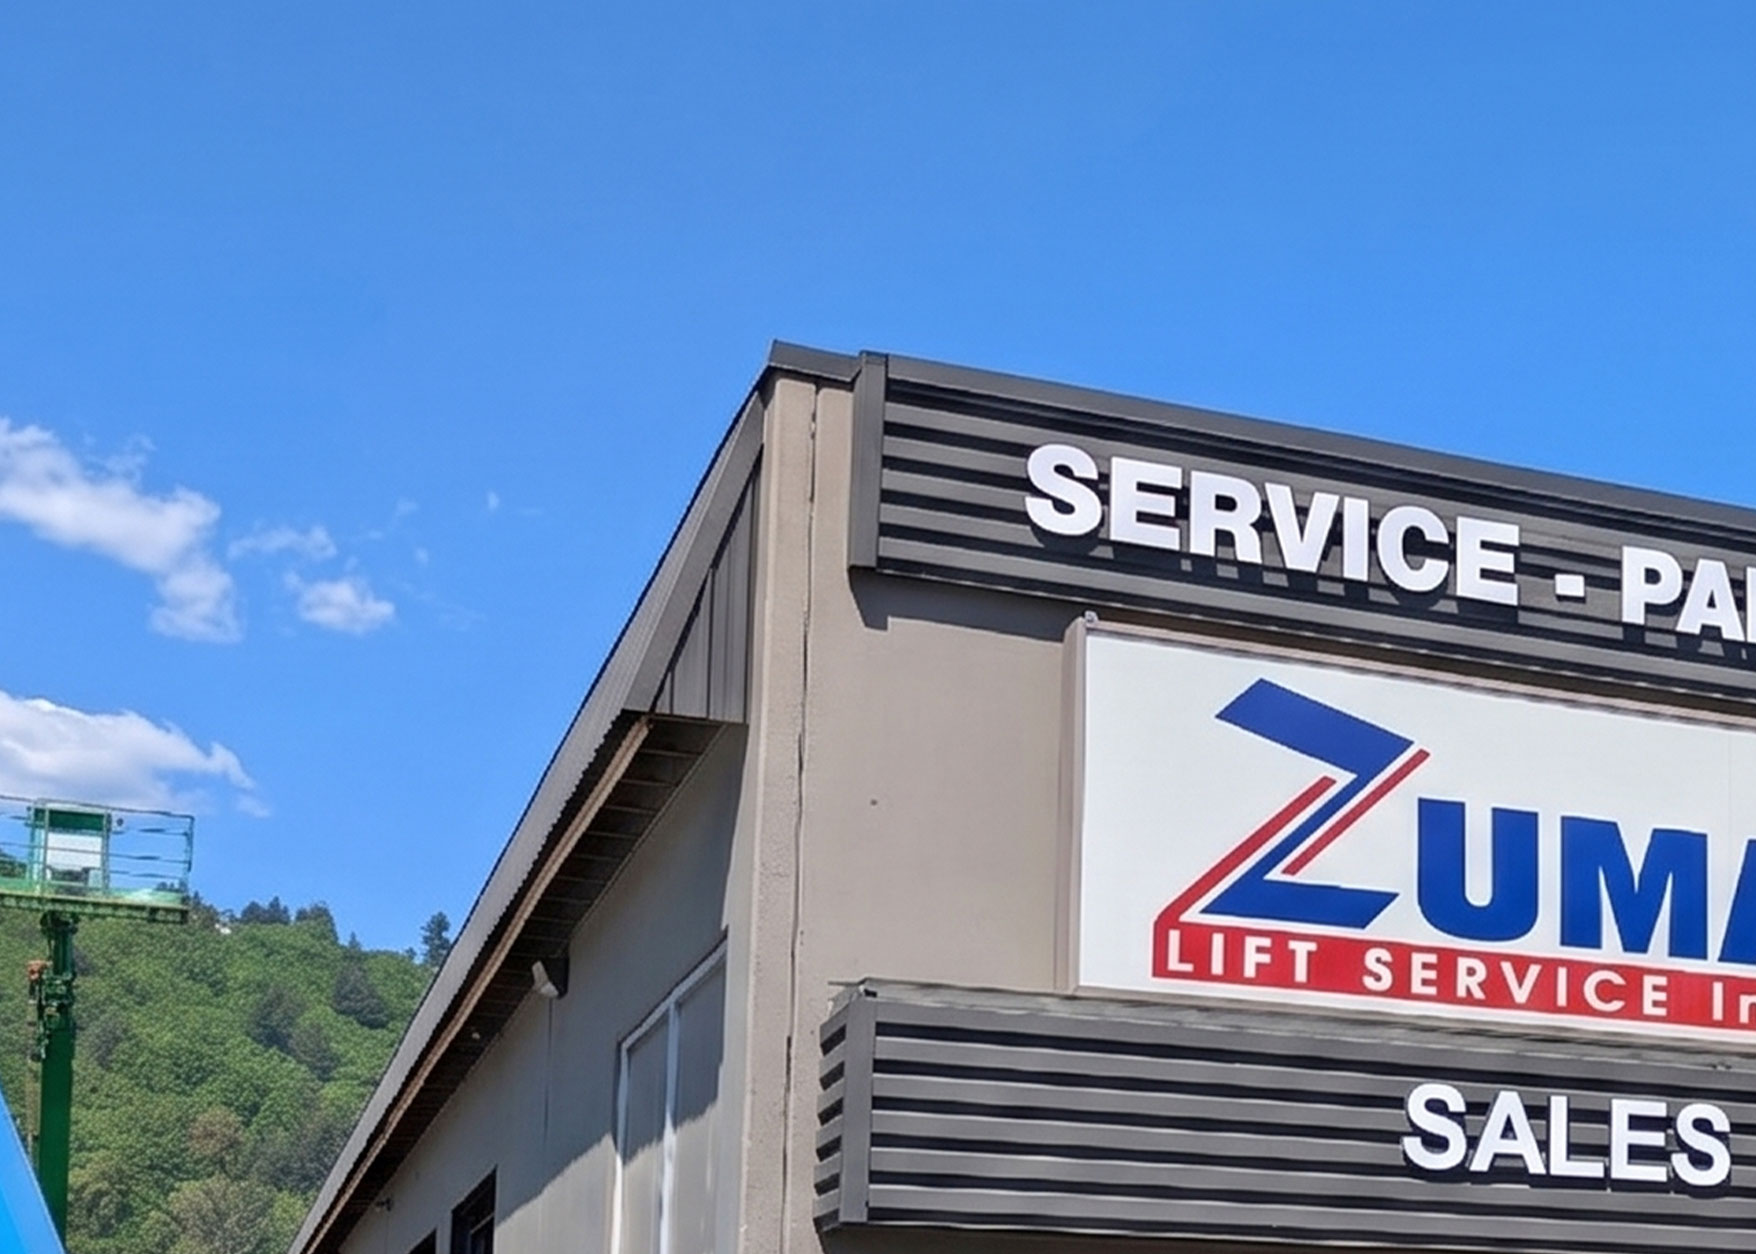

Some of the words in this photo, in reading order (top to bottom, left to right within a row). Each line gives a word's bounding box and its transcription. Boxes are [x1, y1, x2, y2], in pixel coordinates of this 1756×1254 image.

[1025, 444, 1520, 606] SERVICE
[1555, 574, 1585, 598] -
[1167, 929, 1318, 983] LIFT
[1362, 946, 1670, 1016] SERVICE
[1402, 1082, 1732, 1187] SALES
